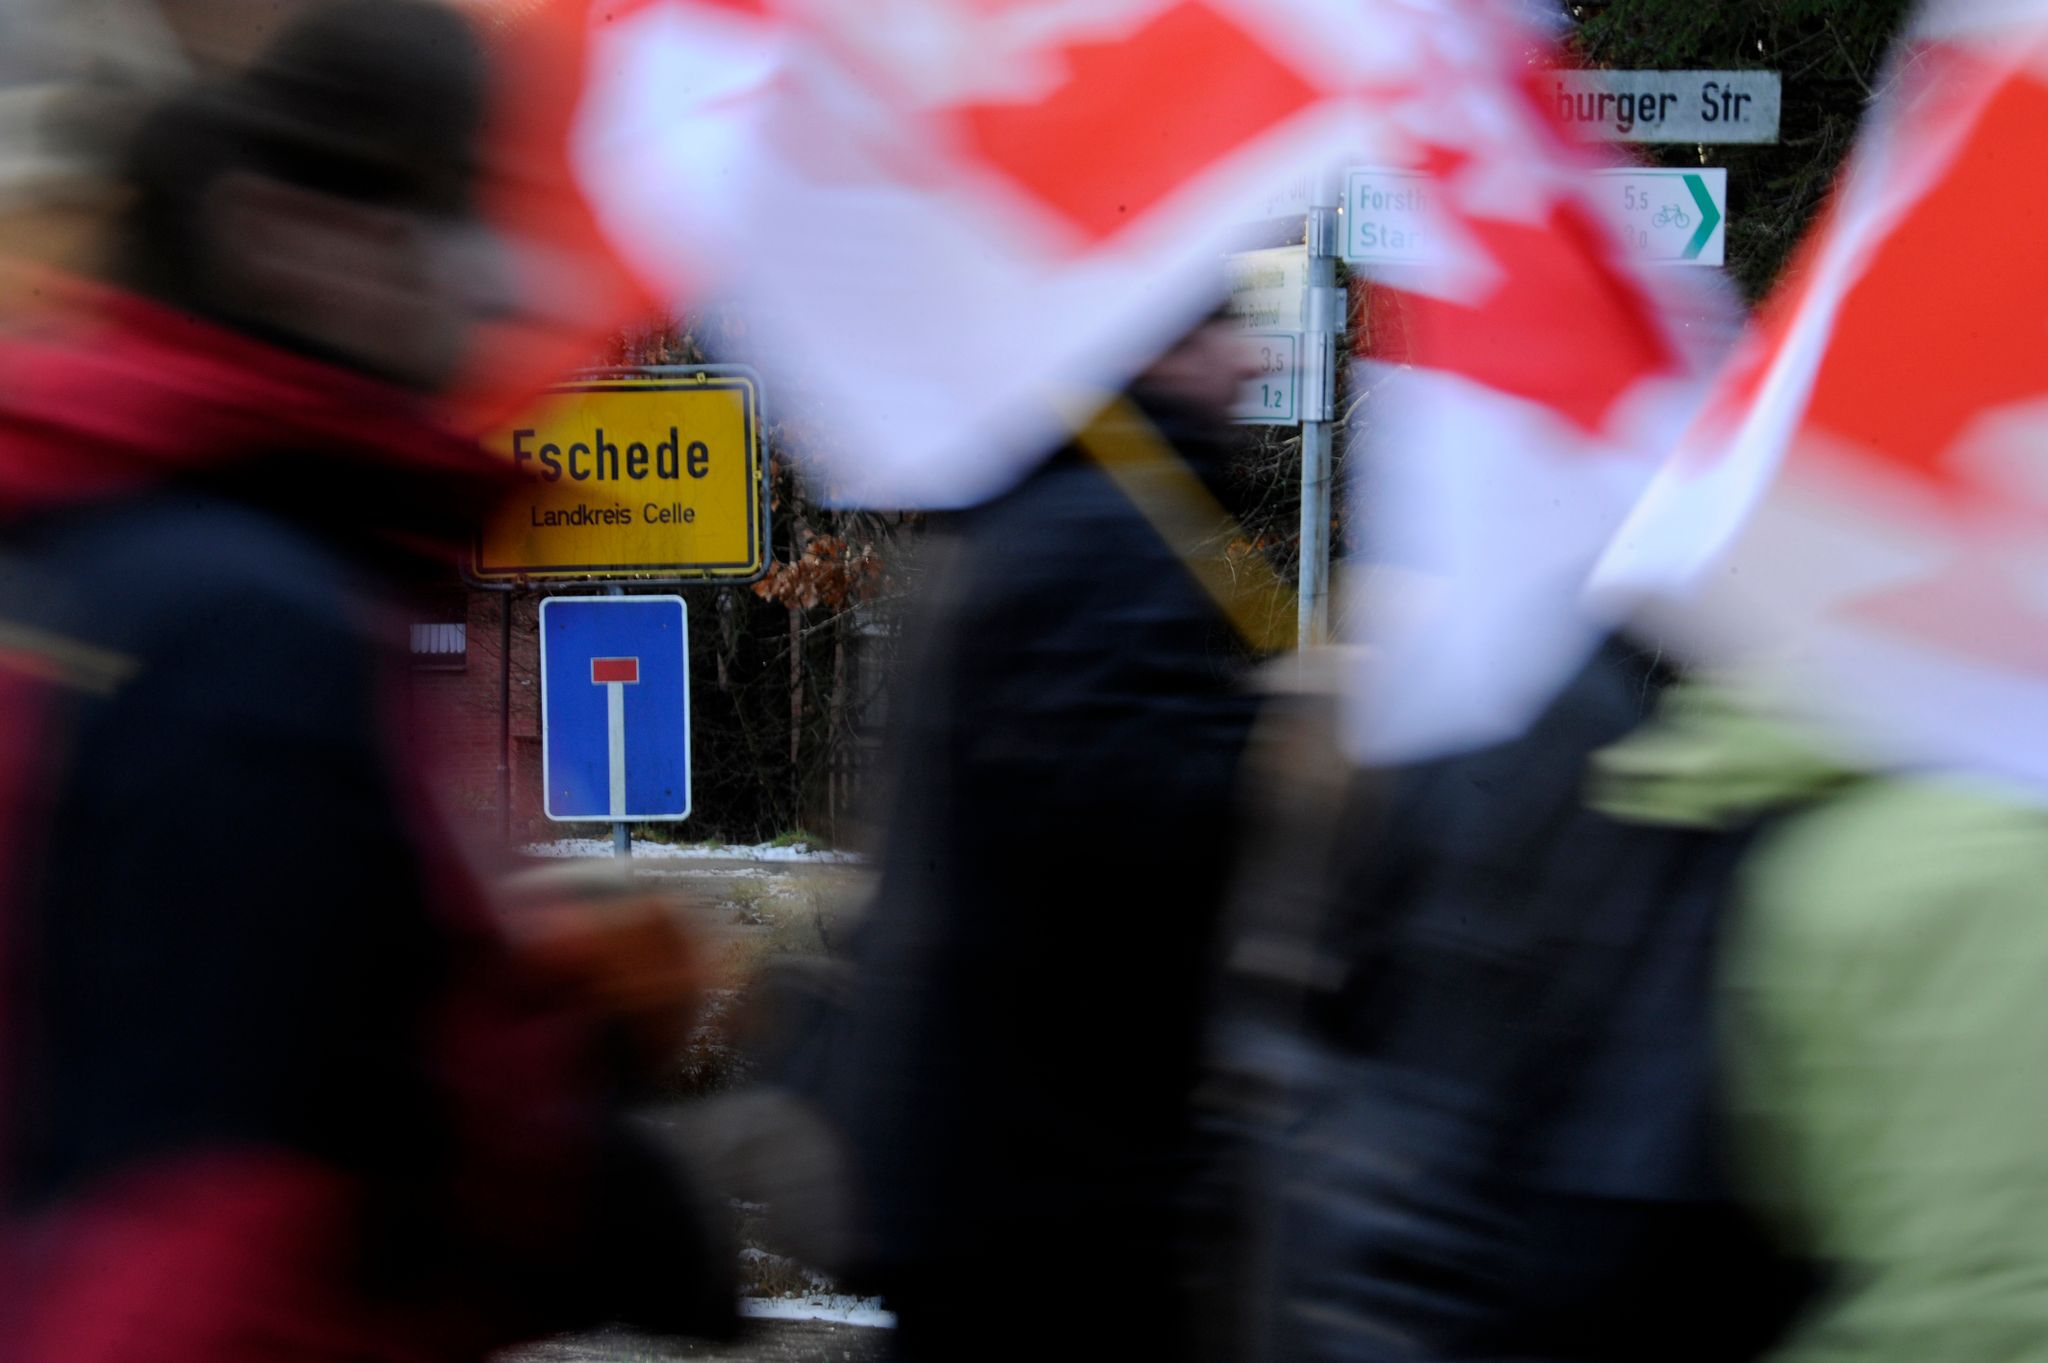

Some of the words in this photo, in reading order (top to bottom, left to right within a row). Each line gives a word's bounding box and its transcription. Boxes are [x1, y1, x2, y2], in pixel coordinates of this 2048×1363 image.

[1556, 81, 1678, 134] burger
[1360, 184, 1428, 212] Forsth
[1624, 185, 1648, 211] 5.5
[1260, 347, 1284, 373] 3.5
[1261, 384, 1282, 408] 1.2
[512, 426, 710, 484] Eschede
[531, 502, 632, 527] Landkreis
[643, 502, 696, 524] Celle
